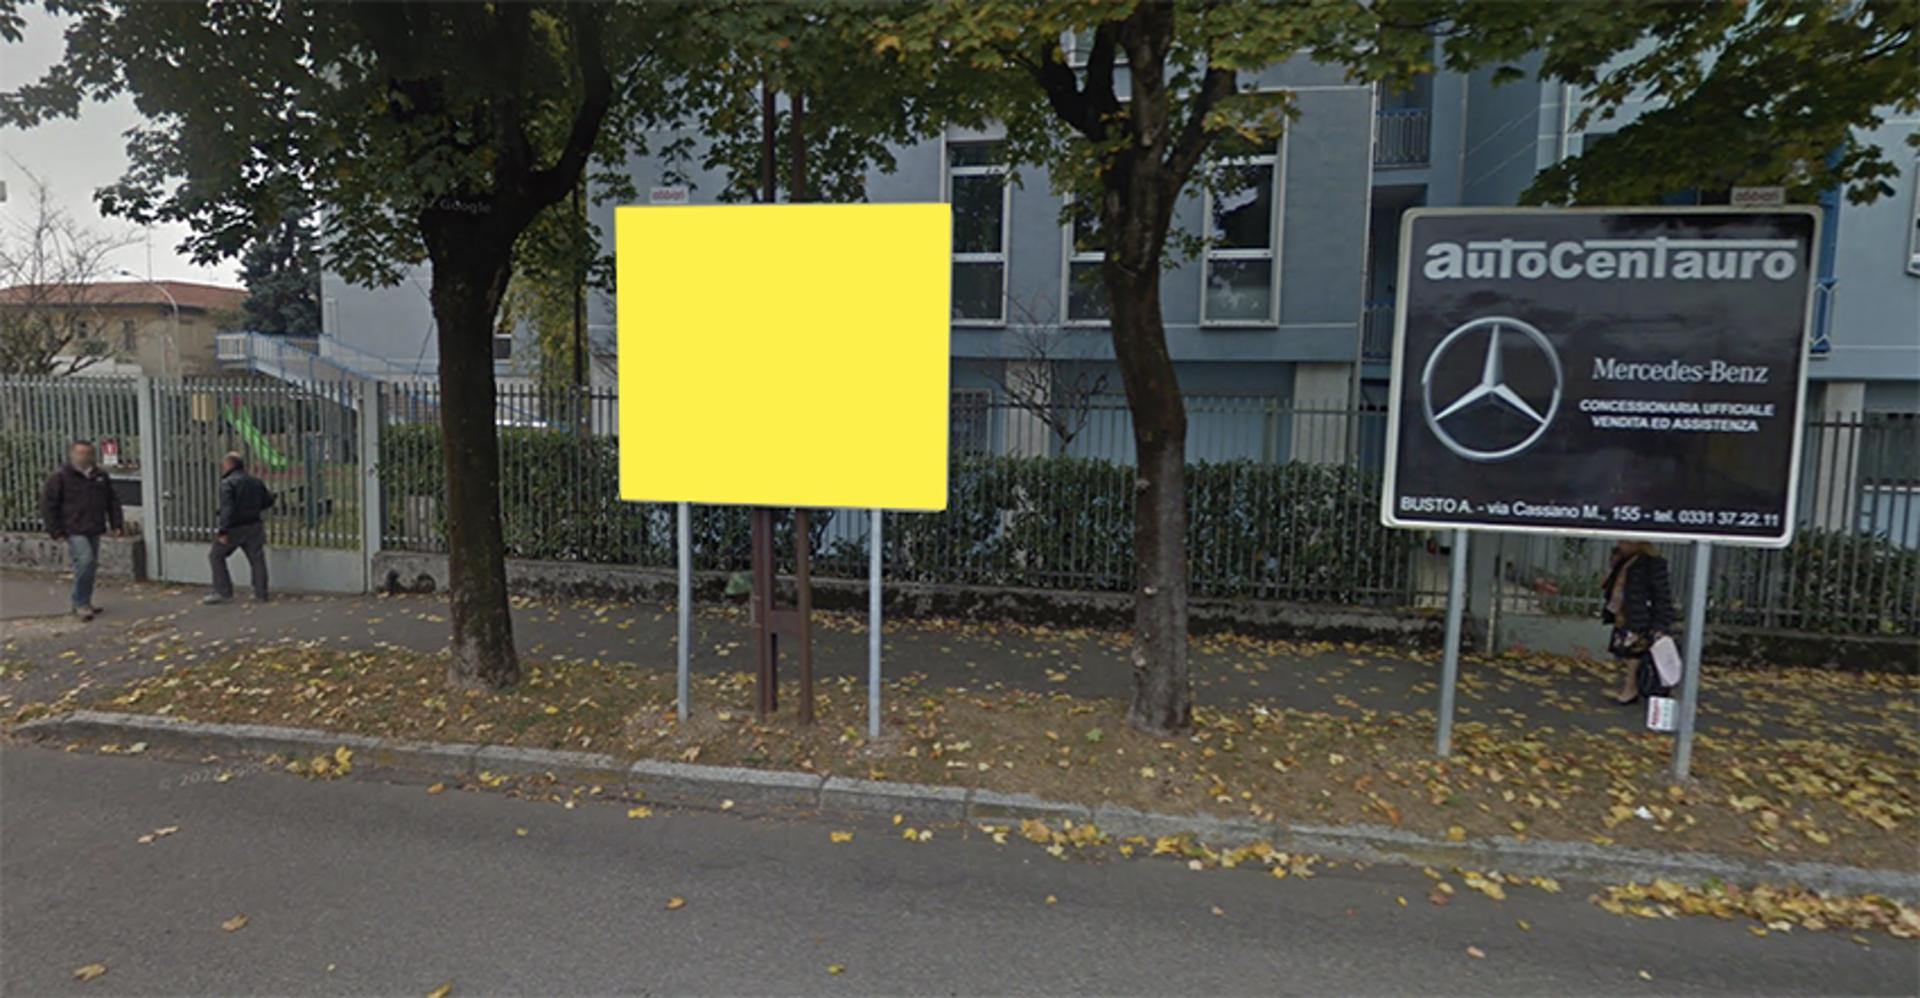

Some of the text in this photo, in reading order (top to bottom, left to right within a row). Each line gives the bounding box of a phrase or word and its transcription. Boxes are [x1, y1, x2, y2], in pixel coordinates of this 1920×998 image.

[1592, 357, 1770, 383] Mercedes-Benz
[1579, 399, 1776, 417] CONCESSIONARIA UFFICIALE
[1592, 415, 1760, 432] VENDITA ED ASSISTENZA
[1401, 496, 1456, 513] BUSTO
[1458, 499, 1474, 514] A.
[1487, 502, 1509, 516] via
[1612, 506, 1641, 522] 155
[1653, 510, 1675, 523] tel.
[1678, 510, 1714, 525] 0331
[1716, 512, 1779, 527] 37.22.11
